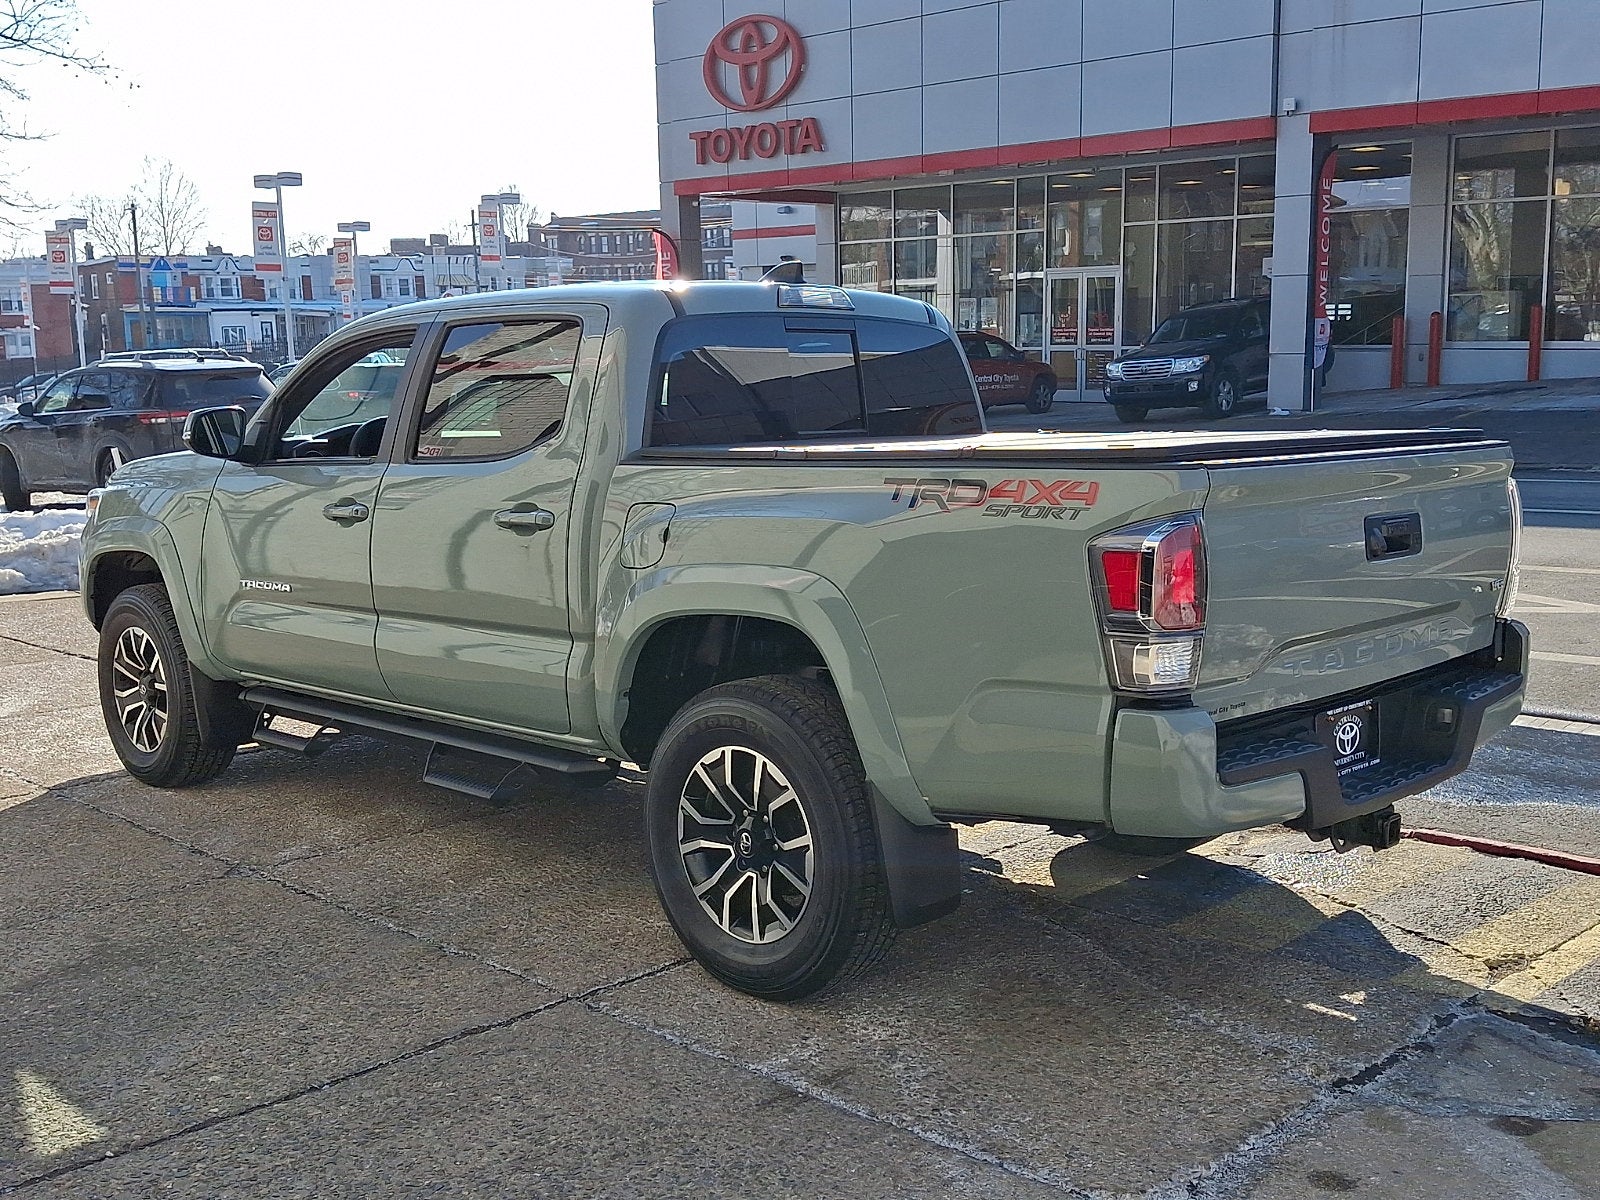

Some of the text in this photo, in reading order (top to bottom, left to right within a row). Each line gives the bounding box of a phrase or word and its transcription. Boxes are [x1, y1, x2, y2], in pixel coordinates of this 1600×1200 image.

[689, 117, 825, 165] TOYOTA
[1319, 177, 1332, 307] WELCOME
[993, 374, 1003, 383] City
[1004, 374, 1019, 382] Toyota
[884, 478, 988, 513] TRD
[982, 504, 1091, 520] SPORT
[240, 579, 292, 593] TACOMA
[1284, 620, 1453, 678] TACOMA
[1352, 715, 1363, 728] CITY
[1355, 752, 1365, 760] CITY
